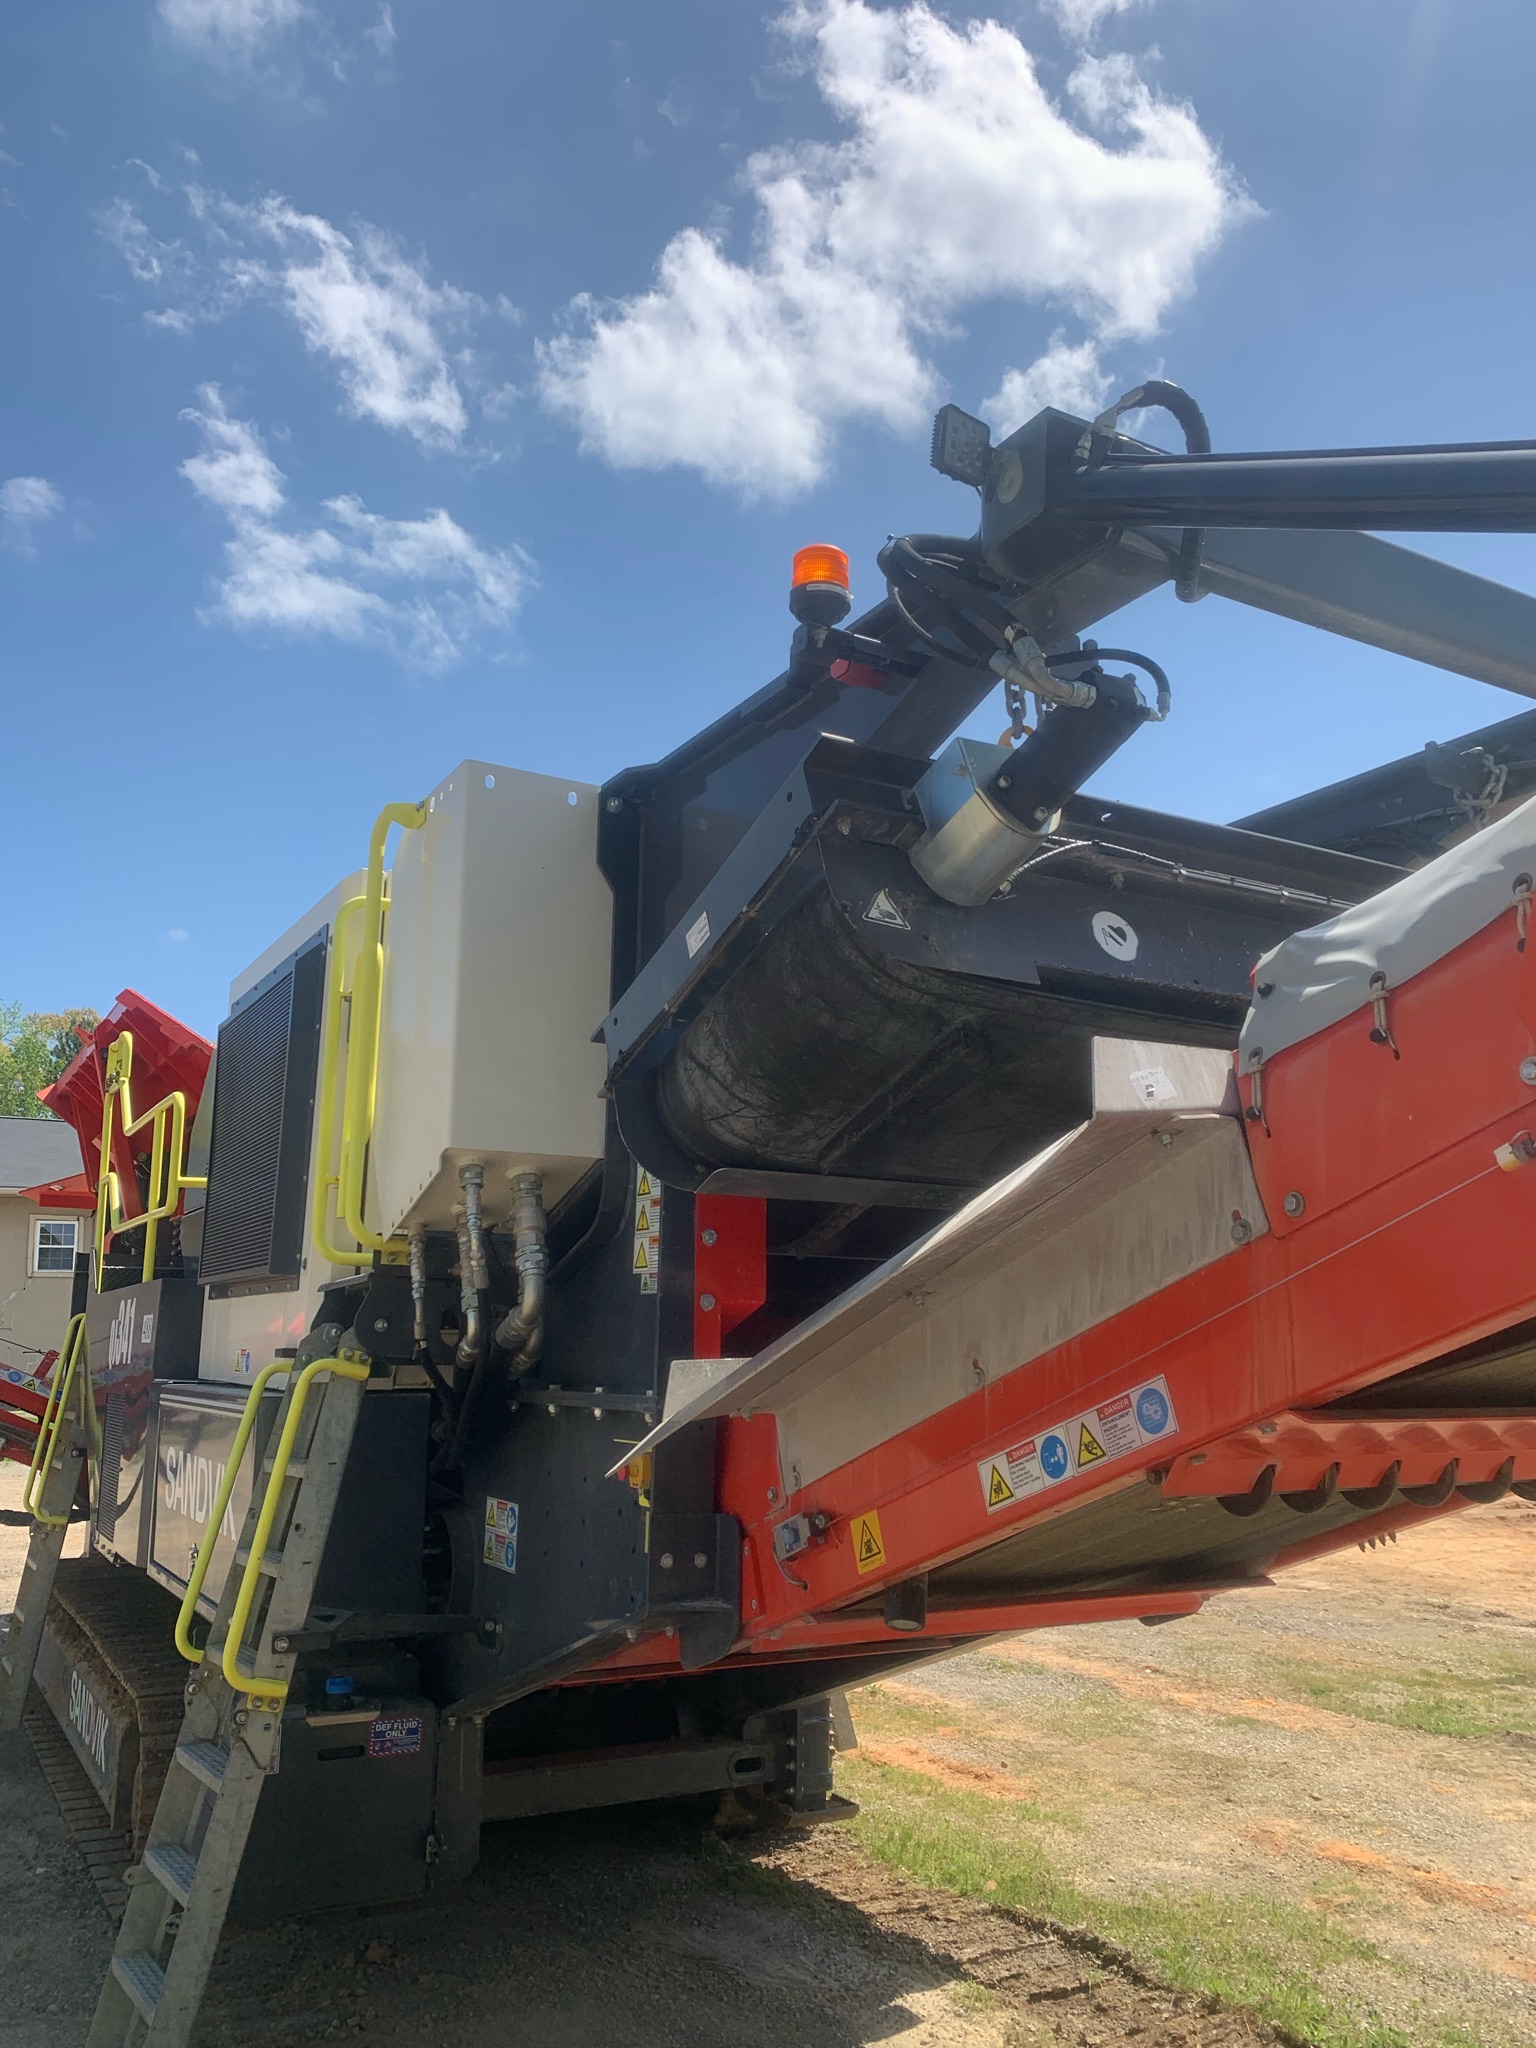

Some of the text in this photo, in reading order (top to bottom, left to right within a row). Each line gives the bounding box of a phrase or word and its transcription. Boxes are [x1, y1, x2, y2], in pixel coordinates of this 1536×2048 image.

[1103, 1398, 1130, 1416] DANGER
[1012, 1443, 1035, 1459] DANGER
[69, 1670, 109, 1774] SANDVIK
[375, 1720, 418, 1732] DEF FLUID
[385, 1729, 408, 1738] ONLY
